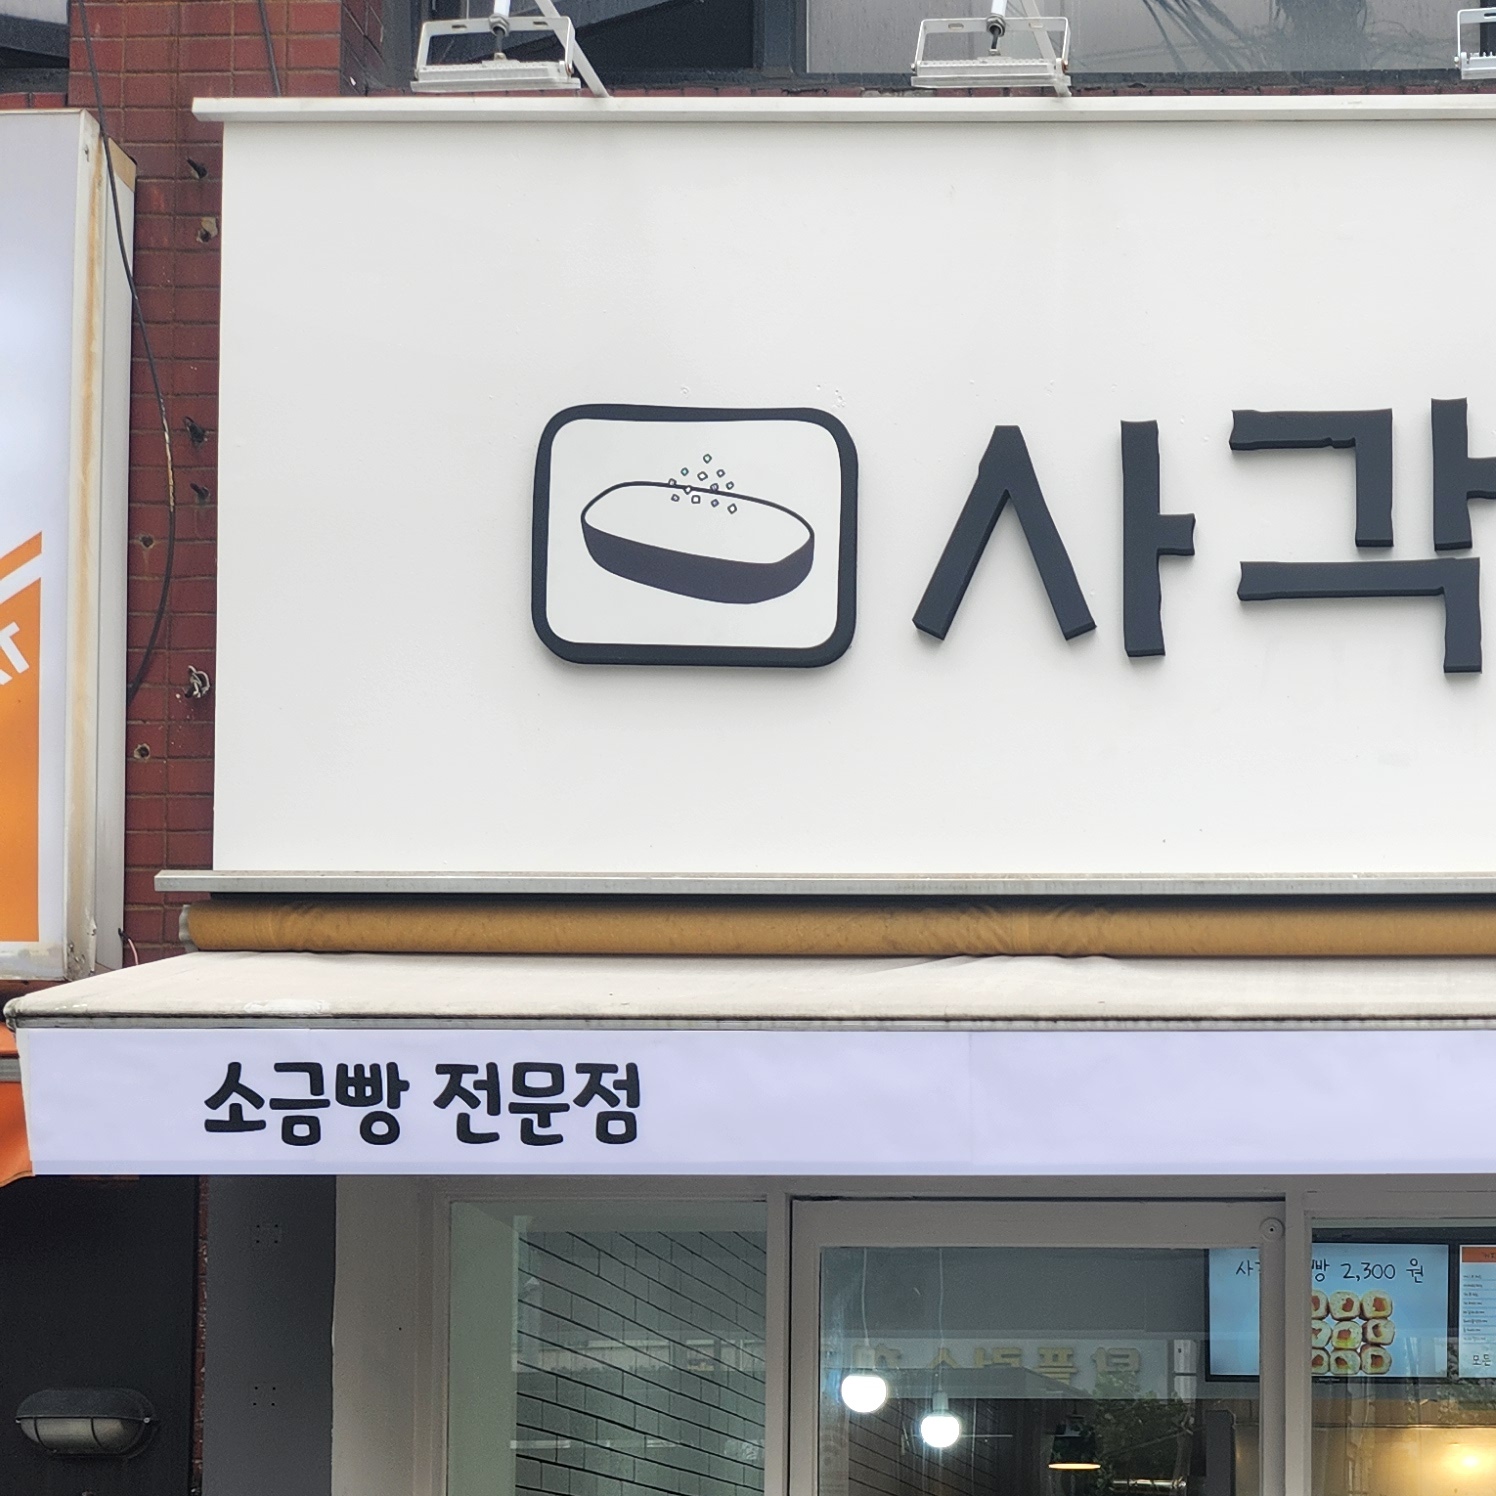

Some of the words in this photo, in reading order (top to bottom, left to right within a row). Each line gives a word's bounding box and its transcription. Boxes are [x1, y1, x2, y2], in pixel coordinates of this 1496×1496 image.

[204, 1061, 410, 1146] 소금빵
[432, 1061, 641, 1145] 전문점
[1340, 1262, 1396, 1282] 2,300
[1406, 1258, 1424, 1283] 원
[1472, 1354, 1492, 1367] 모든
